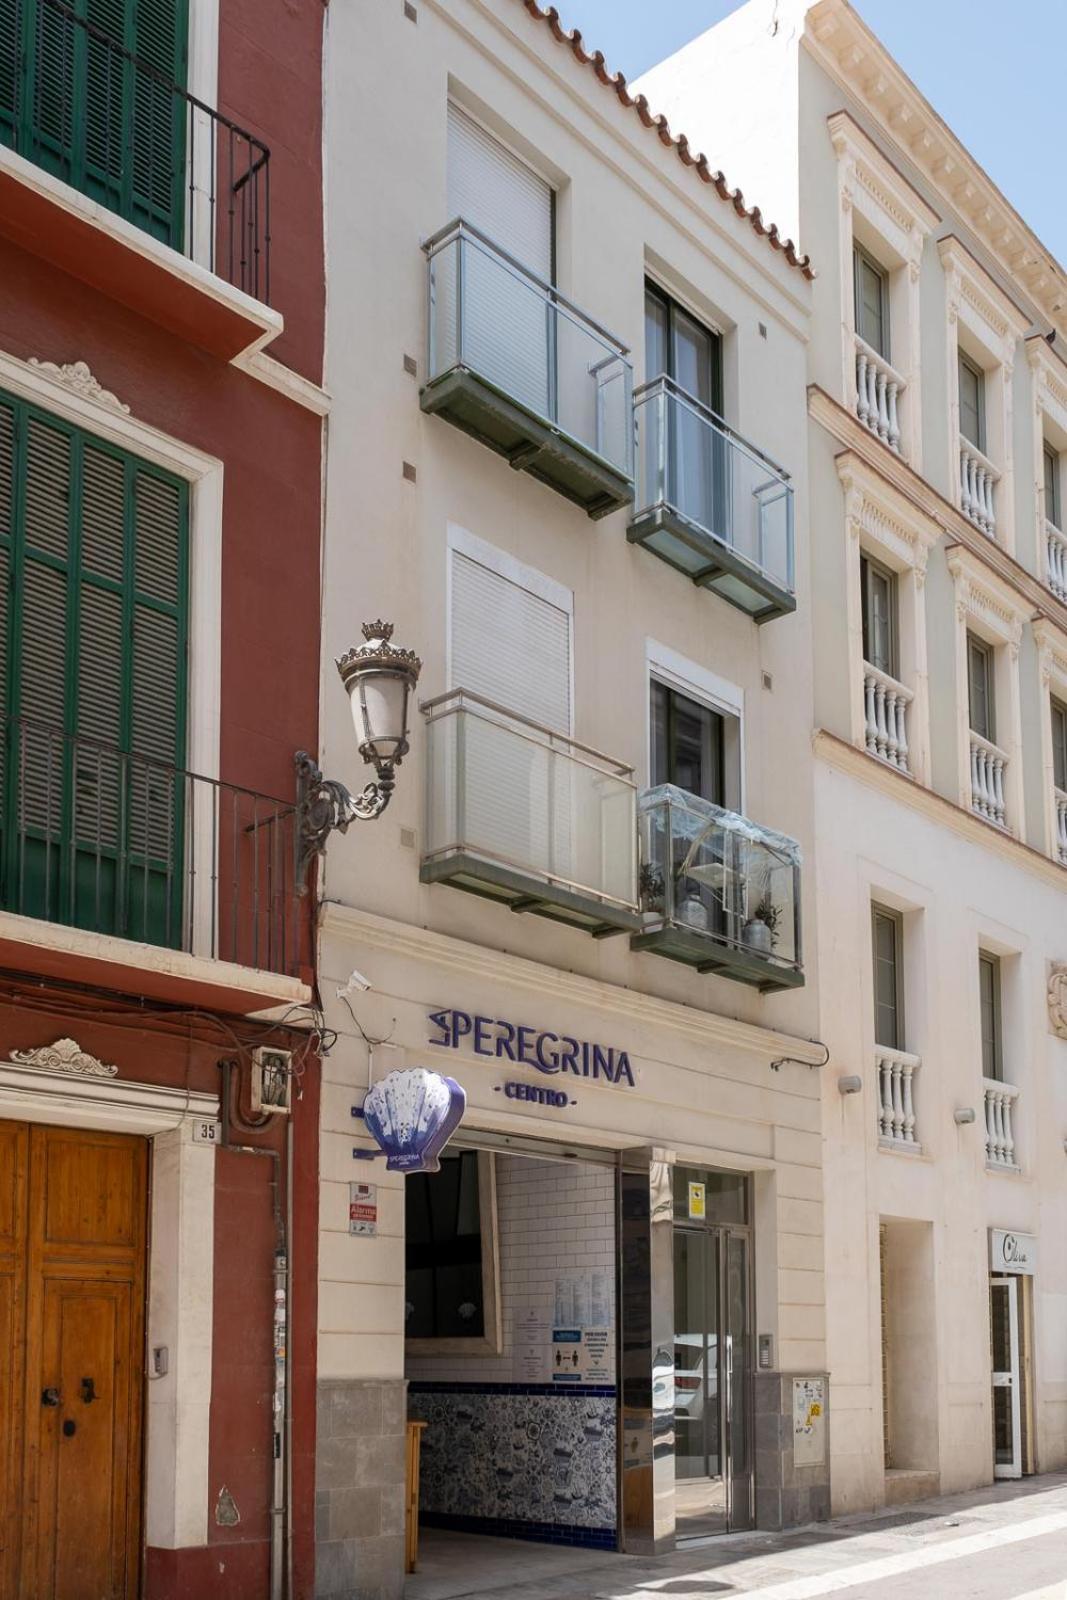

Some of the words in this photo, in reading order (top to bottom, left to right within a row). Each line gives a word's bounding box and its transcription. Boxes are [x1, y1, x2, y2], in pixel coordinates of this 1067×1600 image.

[452, 1009, 636, 1087] PEREGRINA
[504, 1081, 569, 1108] CENTRO
[201, 1124, 215, 1139] 35
